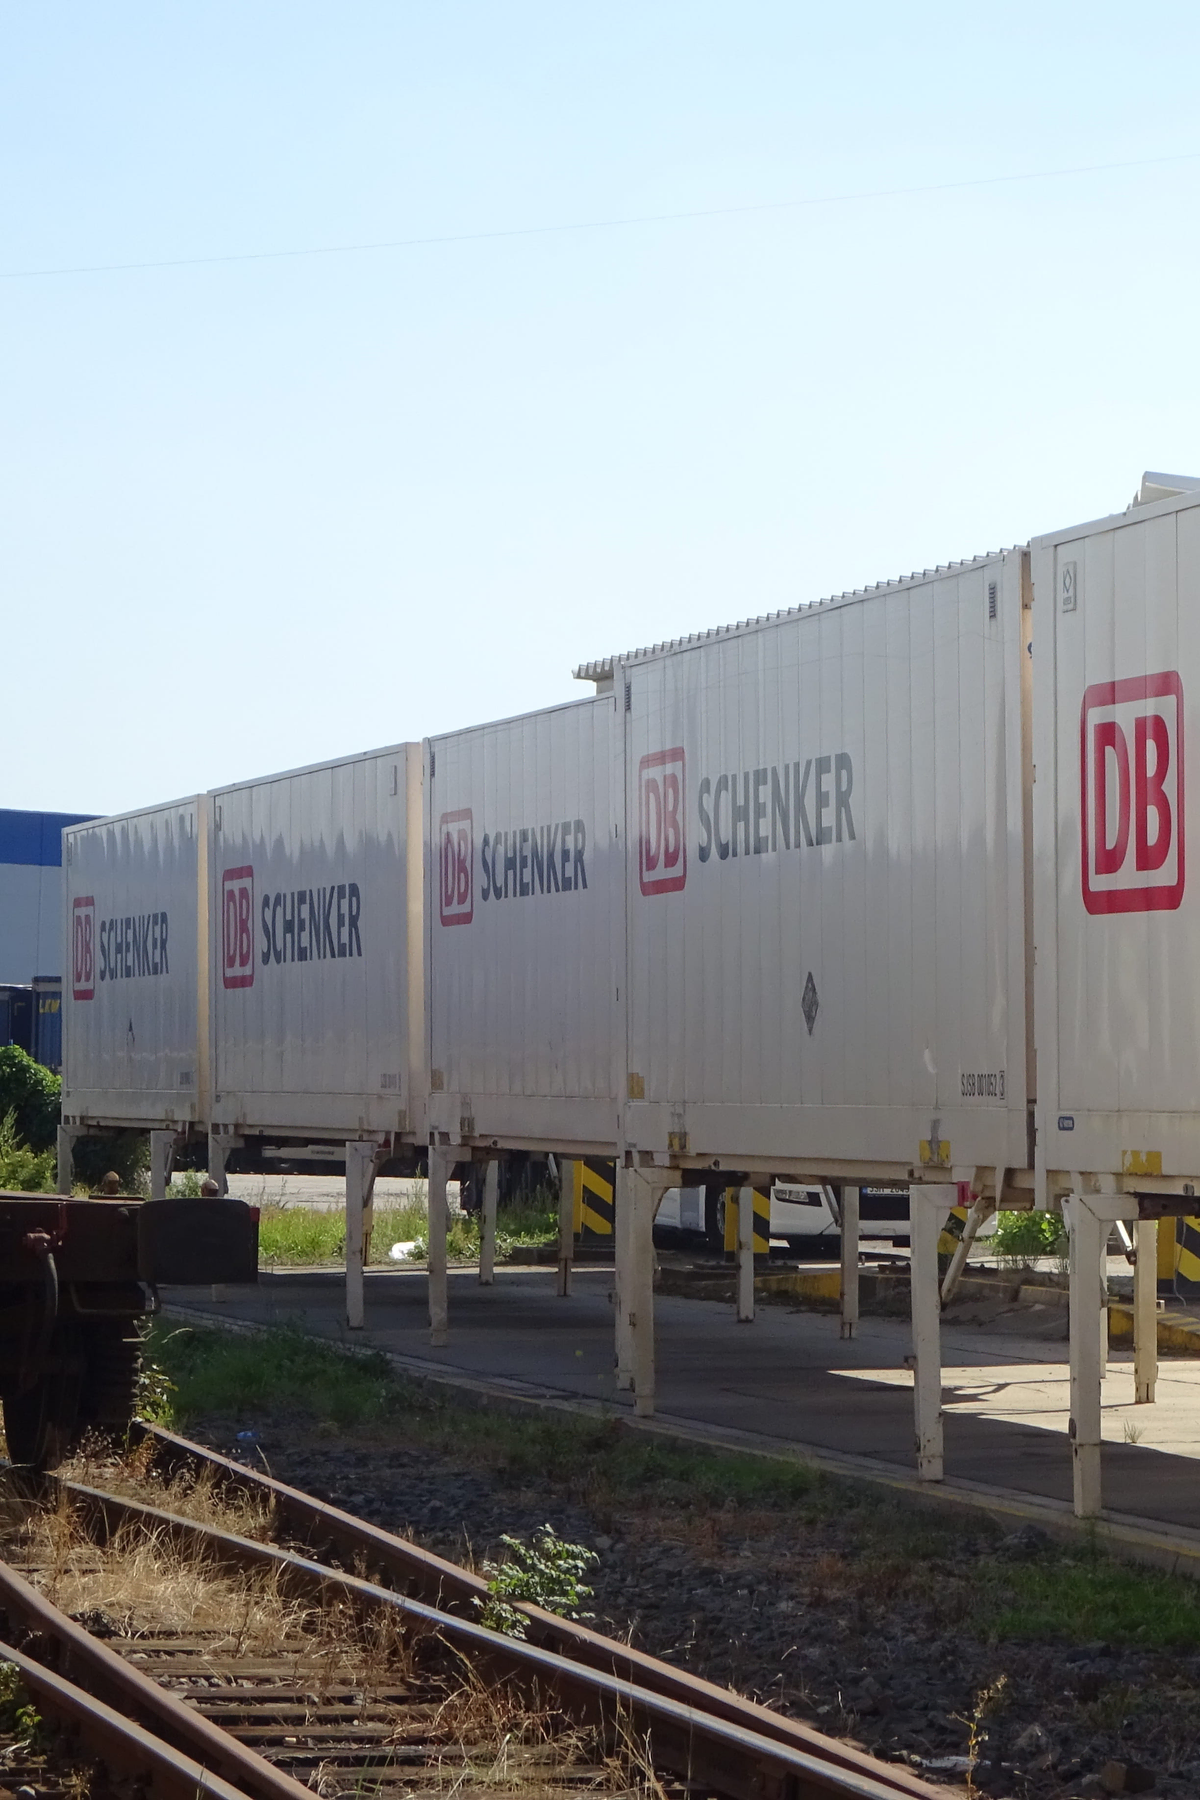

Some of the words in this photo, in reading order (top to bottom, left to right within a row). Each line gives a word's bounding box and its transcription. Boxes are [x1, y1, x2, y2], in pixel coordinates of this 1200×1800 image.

[645, 773, 680, 871] DB
[698, 752, 856, 863] SCHENKER
[1094, 714, 1172, 875] DB
[444, 828, 469, 907] DB
[481, 818, 588, 902] SCHENKER
[75, 914, 92, 983] DB
[100, 912, 169, 981] SCHENKER
[226, 887, 250, 968] DB
[261, 883, 362, 966] SCHENKER
